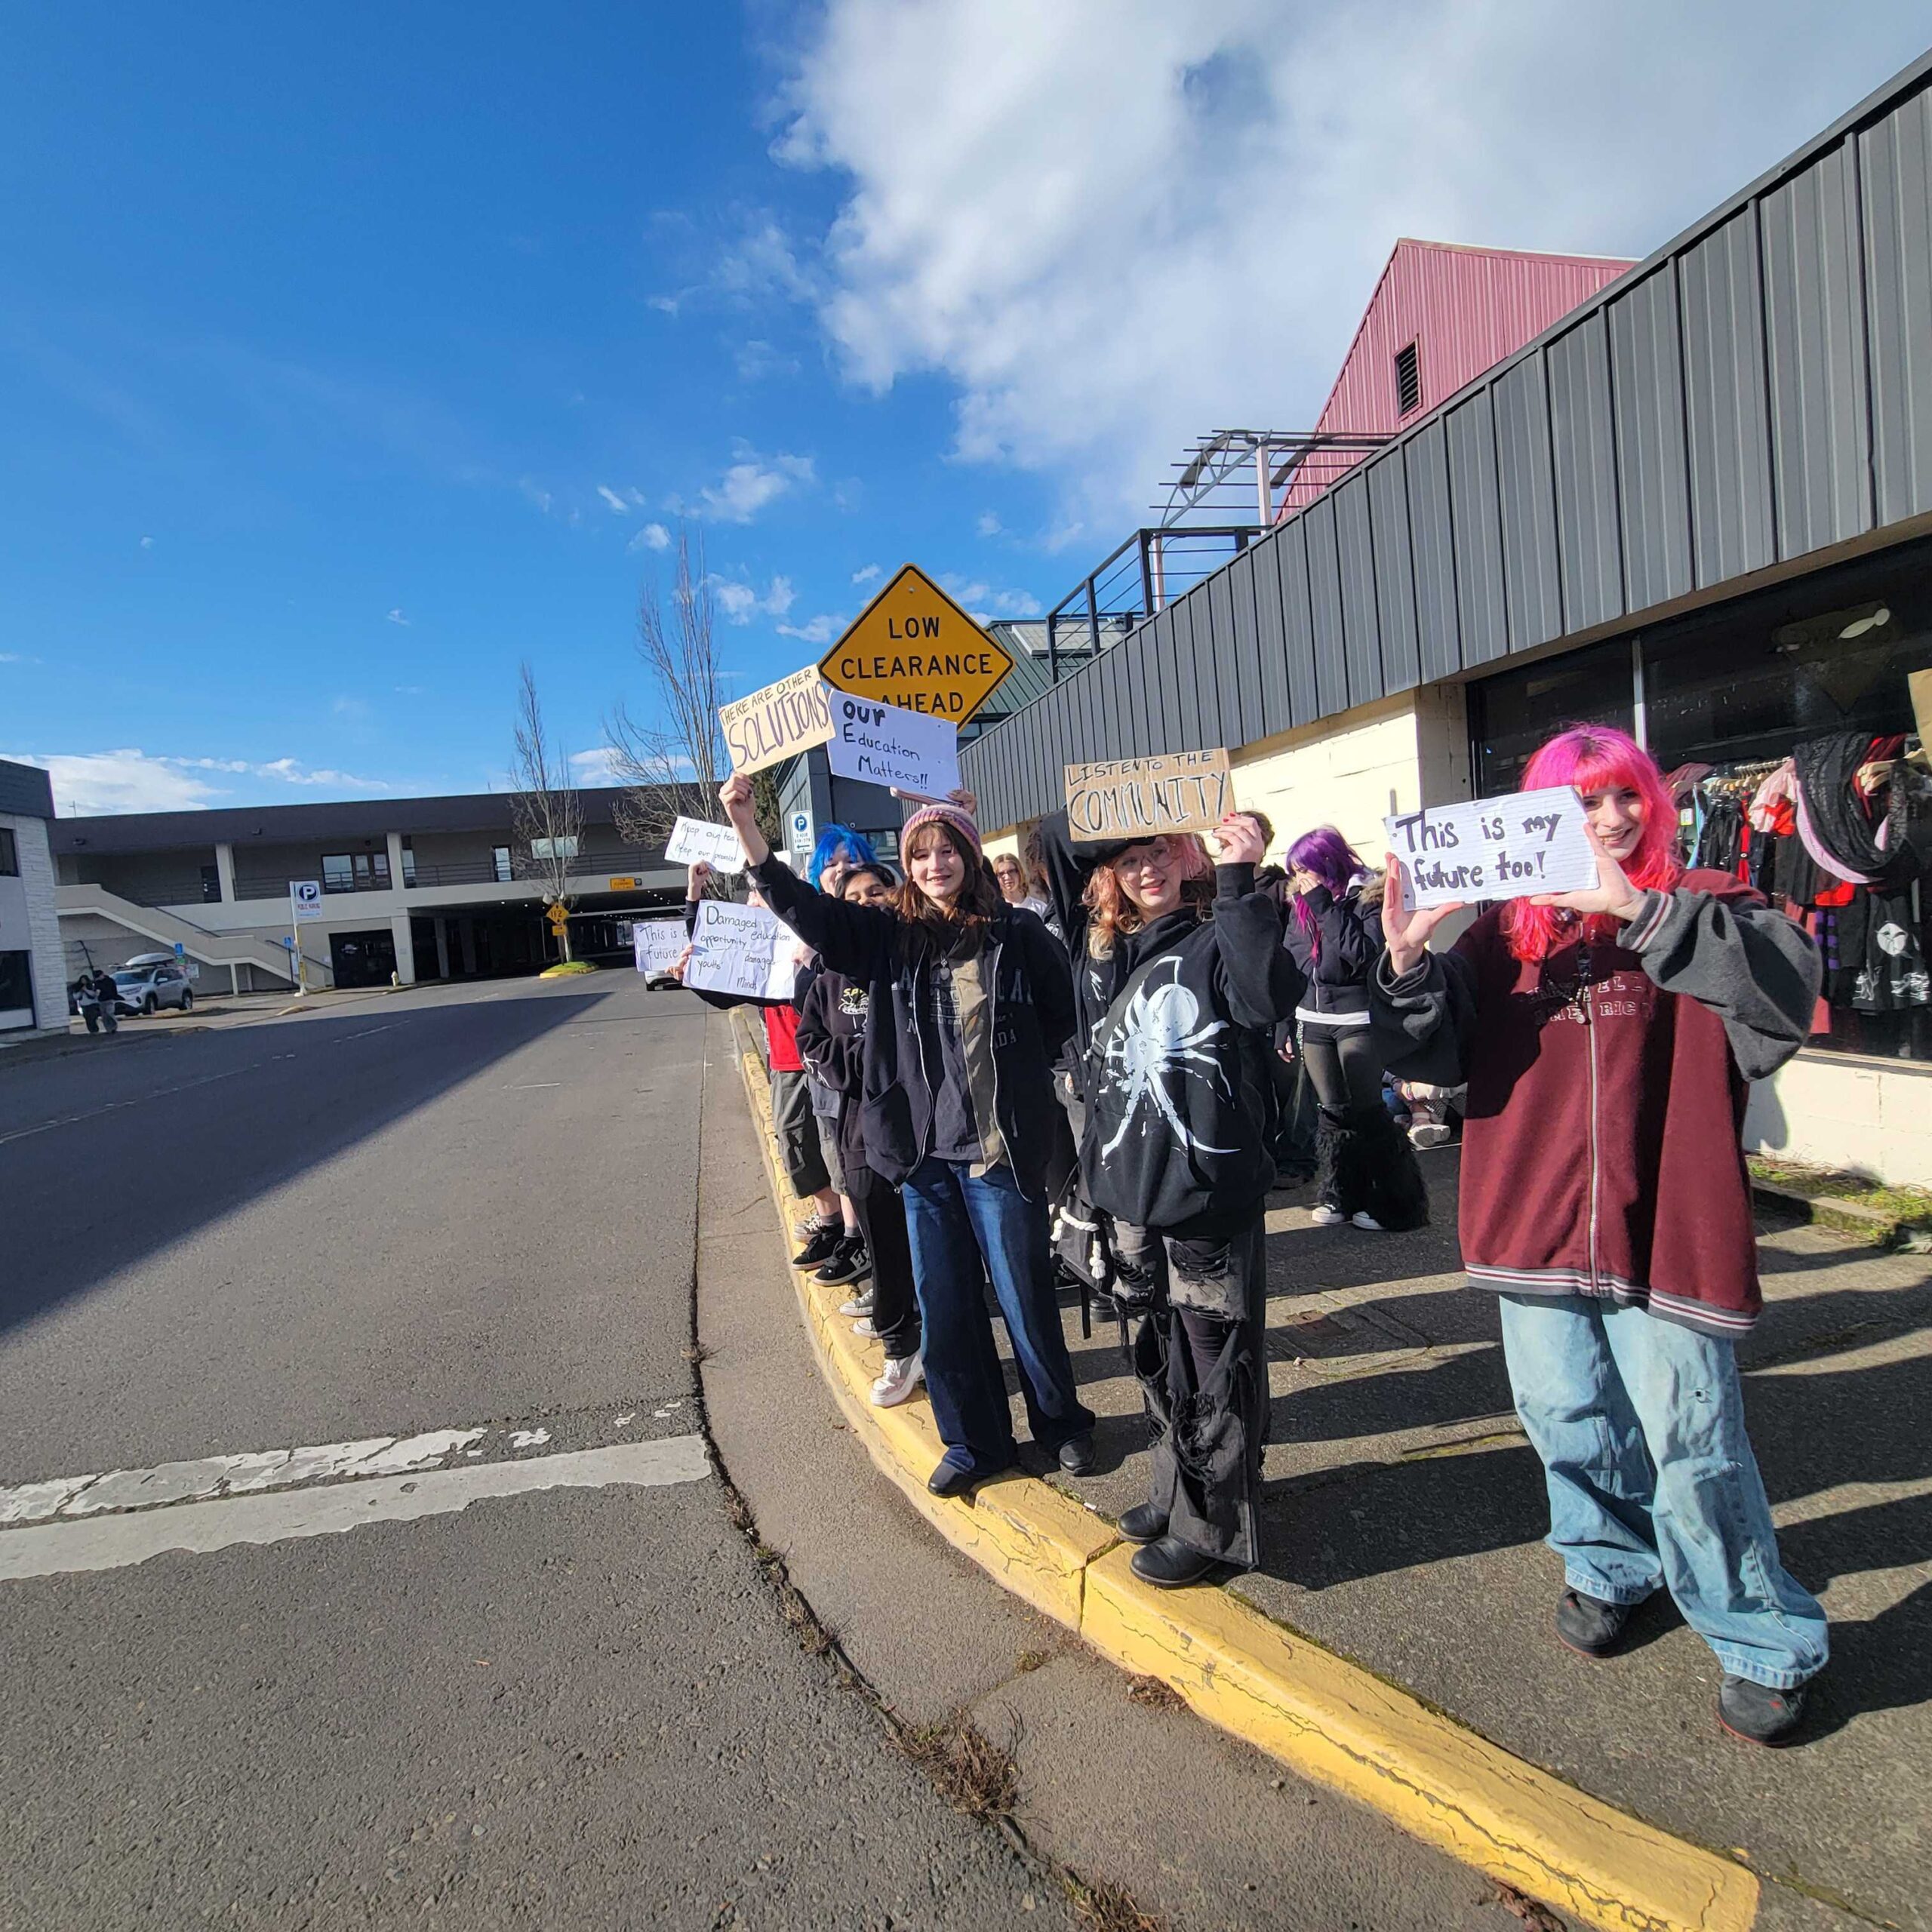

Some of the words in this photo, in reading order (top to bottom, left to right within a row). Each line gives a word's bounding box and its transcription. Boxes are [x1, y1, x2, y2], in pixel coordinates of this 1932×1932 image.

[888, 617, 940, 638] LOW
[841, 654, 993, 679] CLEARANCE
[718, 699, 749, 726] THERE
[752, 688, 774, 708] ARE
[777, 669, 812, 694] OTHER
[728, 681, 829, 769] SOLUTIONS
[843, 722, 920, 761] Education
[858, 755, 928, 789] Matters!!
[1068, 760, 1142, 786] LISTEN
[1145, 758, 1163, 772] TO
[1173, 751, 1214, 767] THE
[1070, 771, 1226, 833] COMMUNITY
[1395, 810, 1460, 853] This
[1481, 817, 1503, 841] is
[1521, 813, 1562, 842] my
[1414, 858, 1484, 891] future
[1495, 851, 1546, 881] too!
[639, 925, 665, 944] This
[670, 928, 678, 939] is
[706, 906, 757, 932] Damaged
[750, 931, 790, 941] education
[646, 944, 678, 960] future
[700, 935, 746, 949] opportunity
